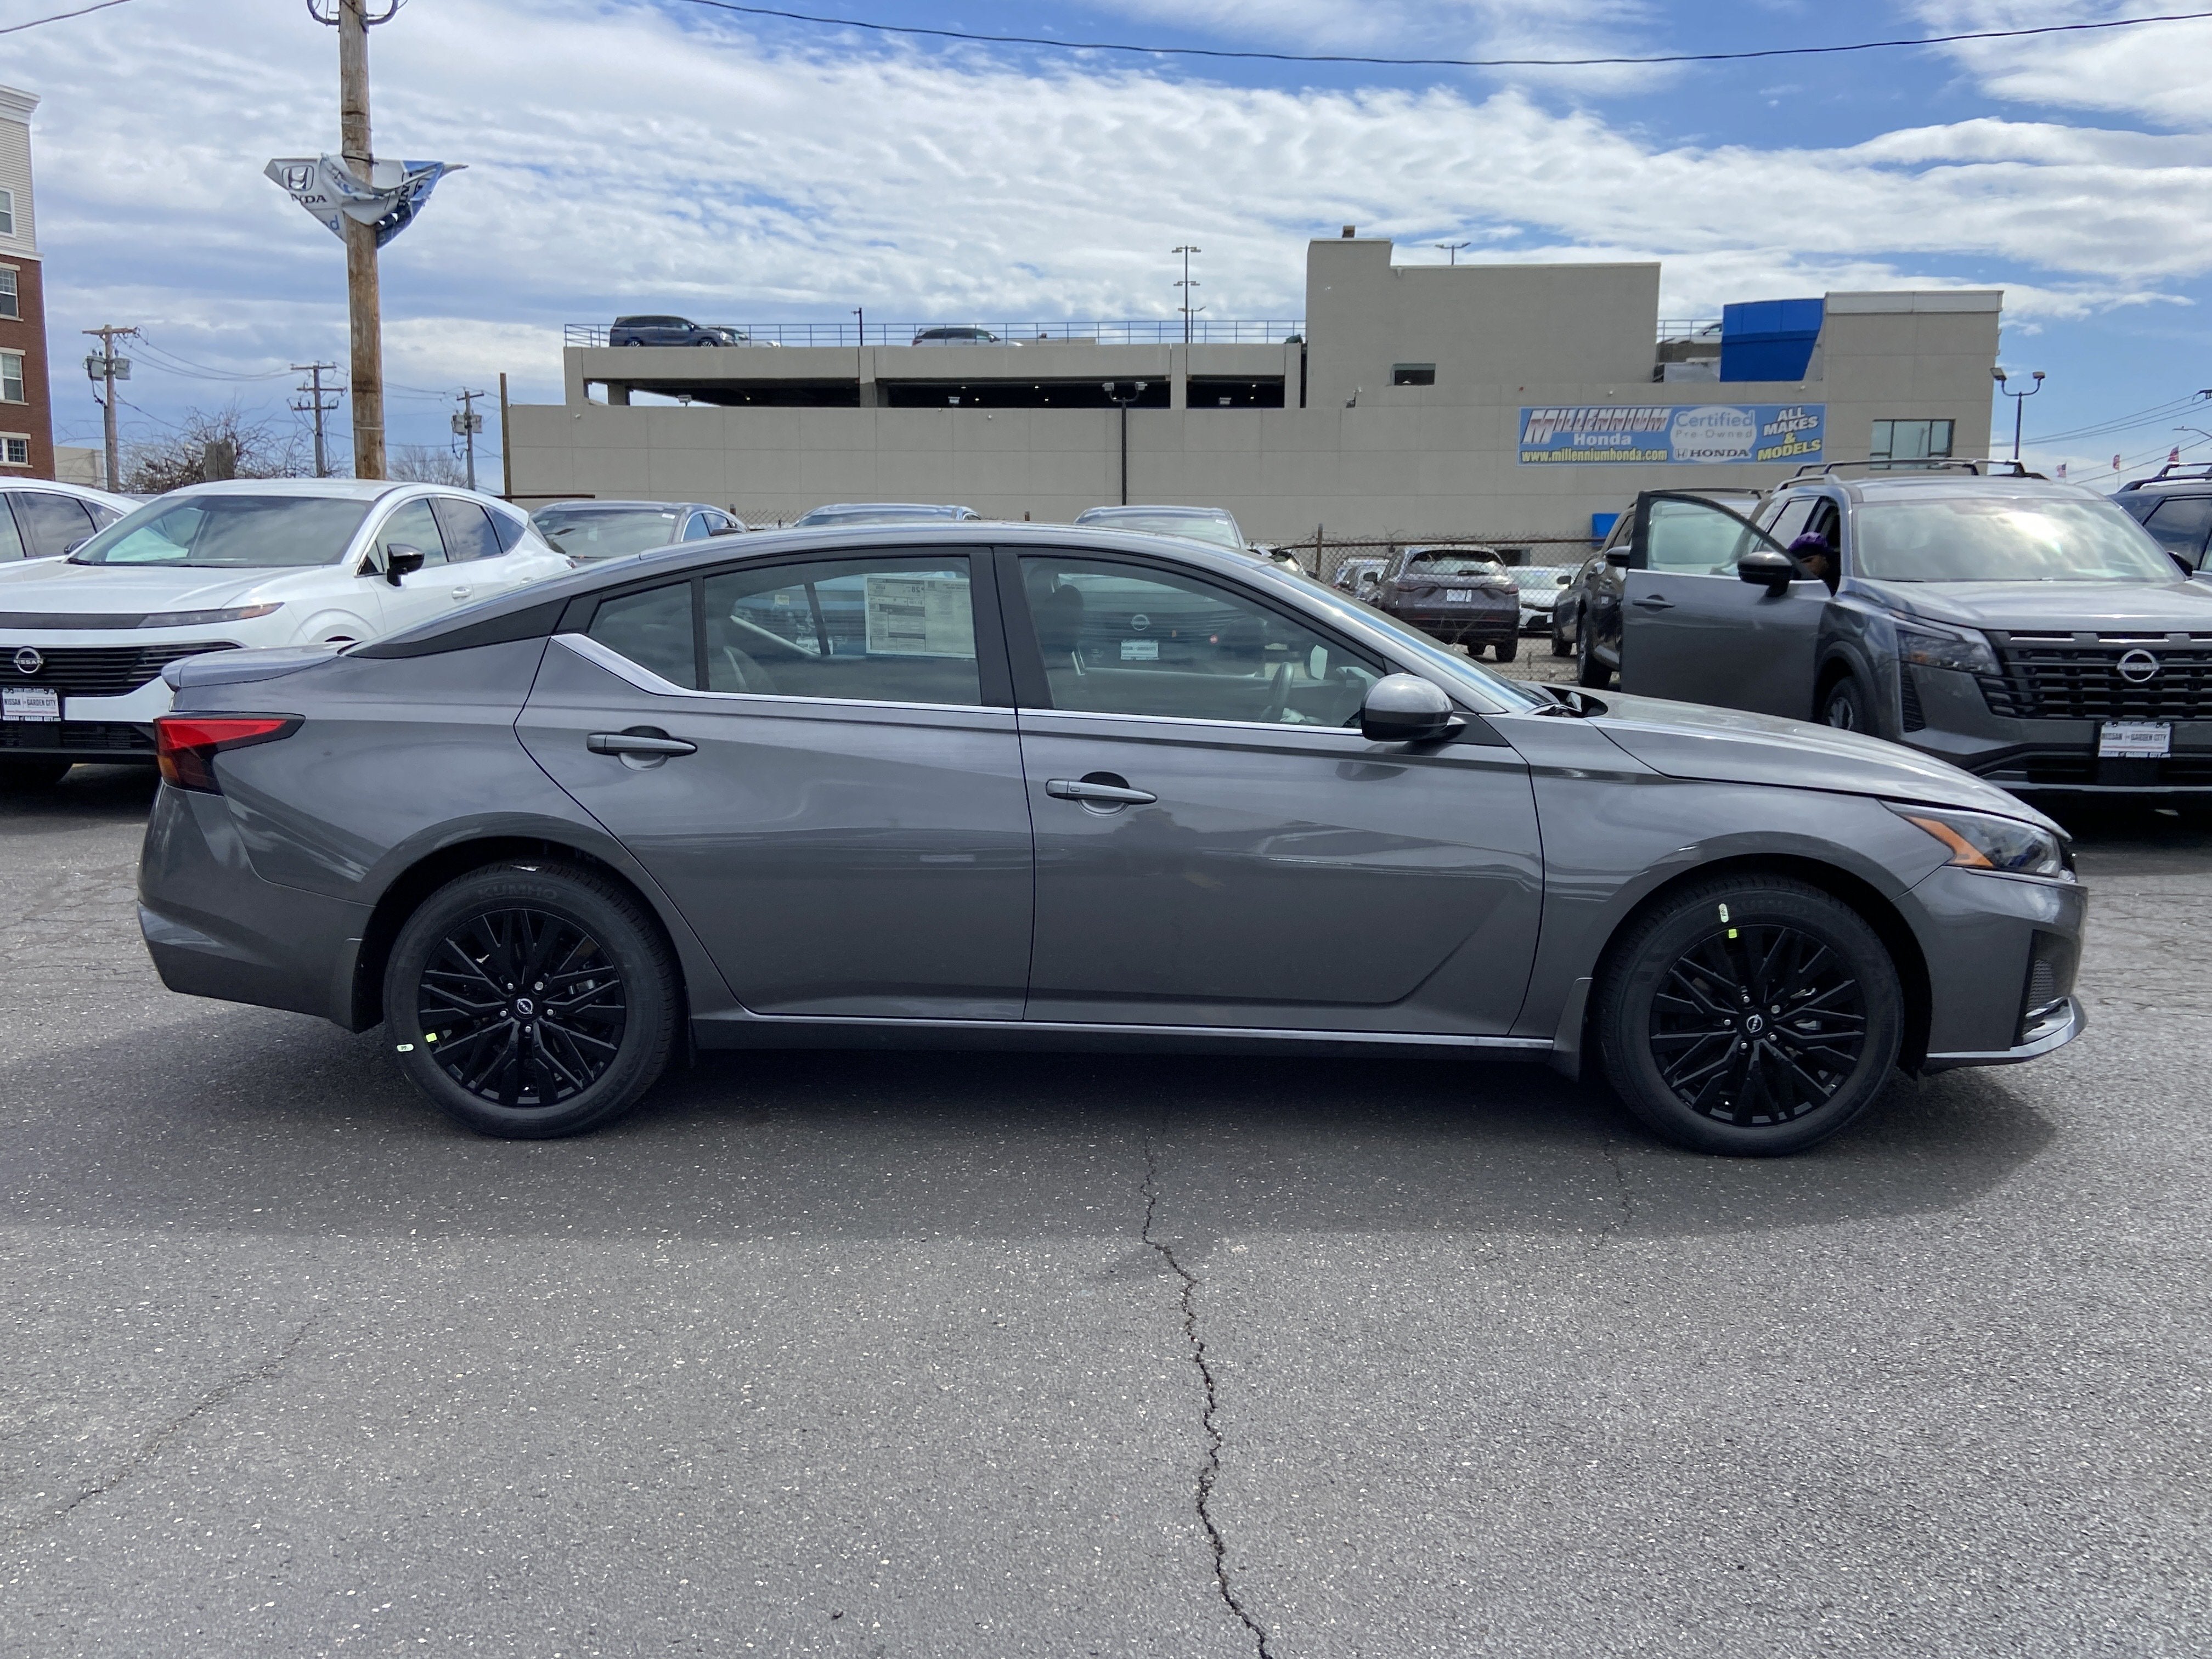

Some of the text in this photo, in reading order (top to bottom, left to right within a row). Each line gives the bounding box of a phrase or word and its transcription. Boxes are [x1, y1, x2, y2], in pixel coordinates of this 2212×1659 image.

[1675, 410, 1756, 427] Certified
[1778, 407, 1805, 421] ALL
[1763, 416, 1819, 436] MAKES
[1573, 433, 1632, 446] Honda
[1784, 432, 1796, 444] &
[1522, 448, 1668, 462] www.millenniumhonda.com
[1690, 449, 1750, 458] HONDA
[1757, 438, 1822, 462] MODELS
